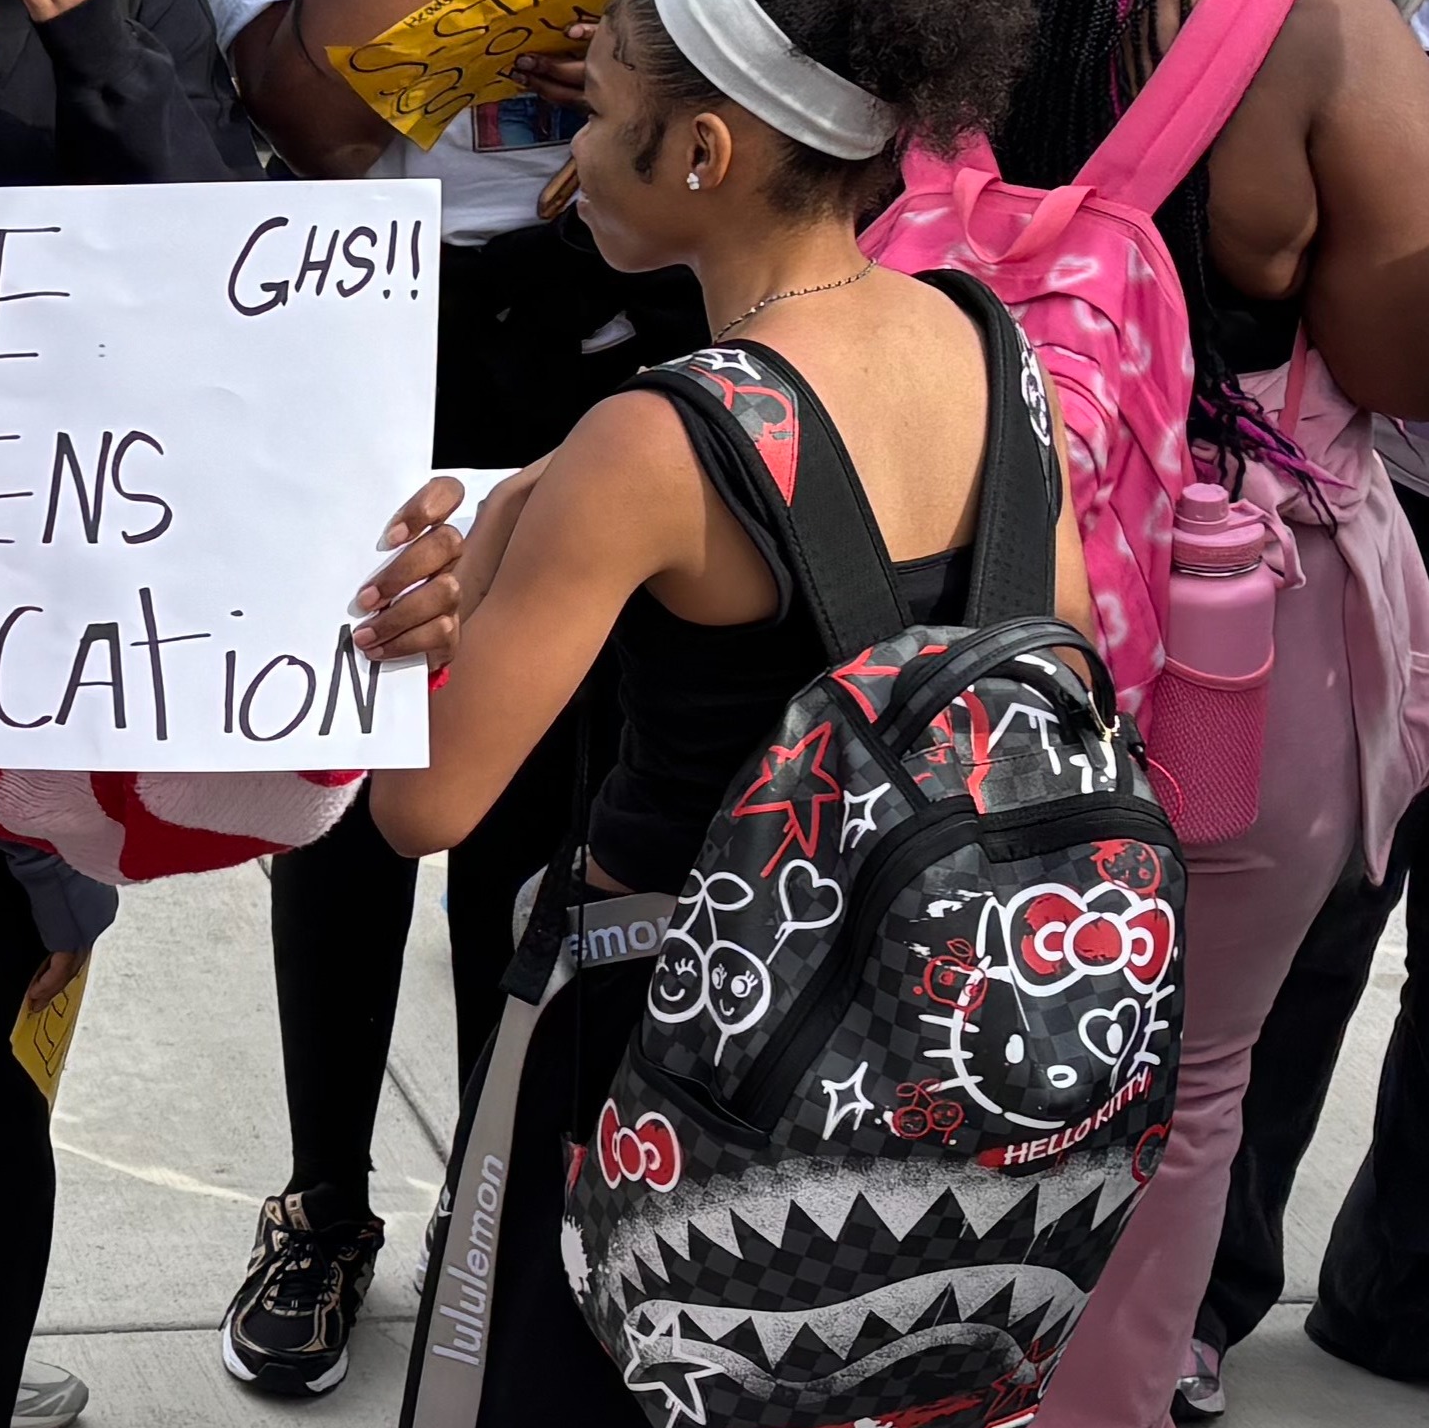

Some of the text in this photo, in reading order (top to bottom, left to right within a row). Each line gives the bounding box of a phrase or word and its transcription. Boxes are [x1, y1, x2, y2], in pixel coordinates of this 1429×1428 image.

[228, 217, 422, 316] GHS!!
[1004, 1066, 1149, 1165] HELLO KITTY
[432, 1153, 503, 1366] lululemon
